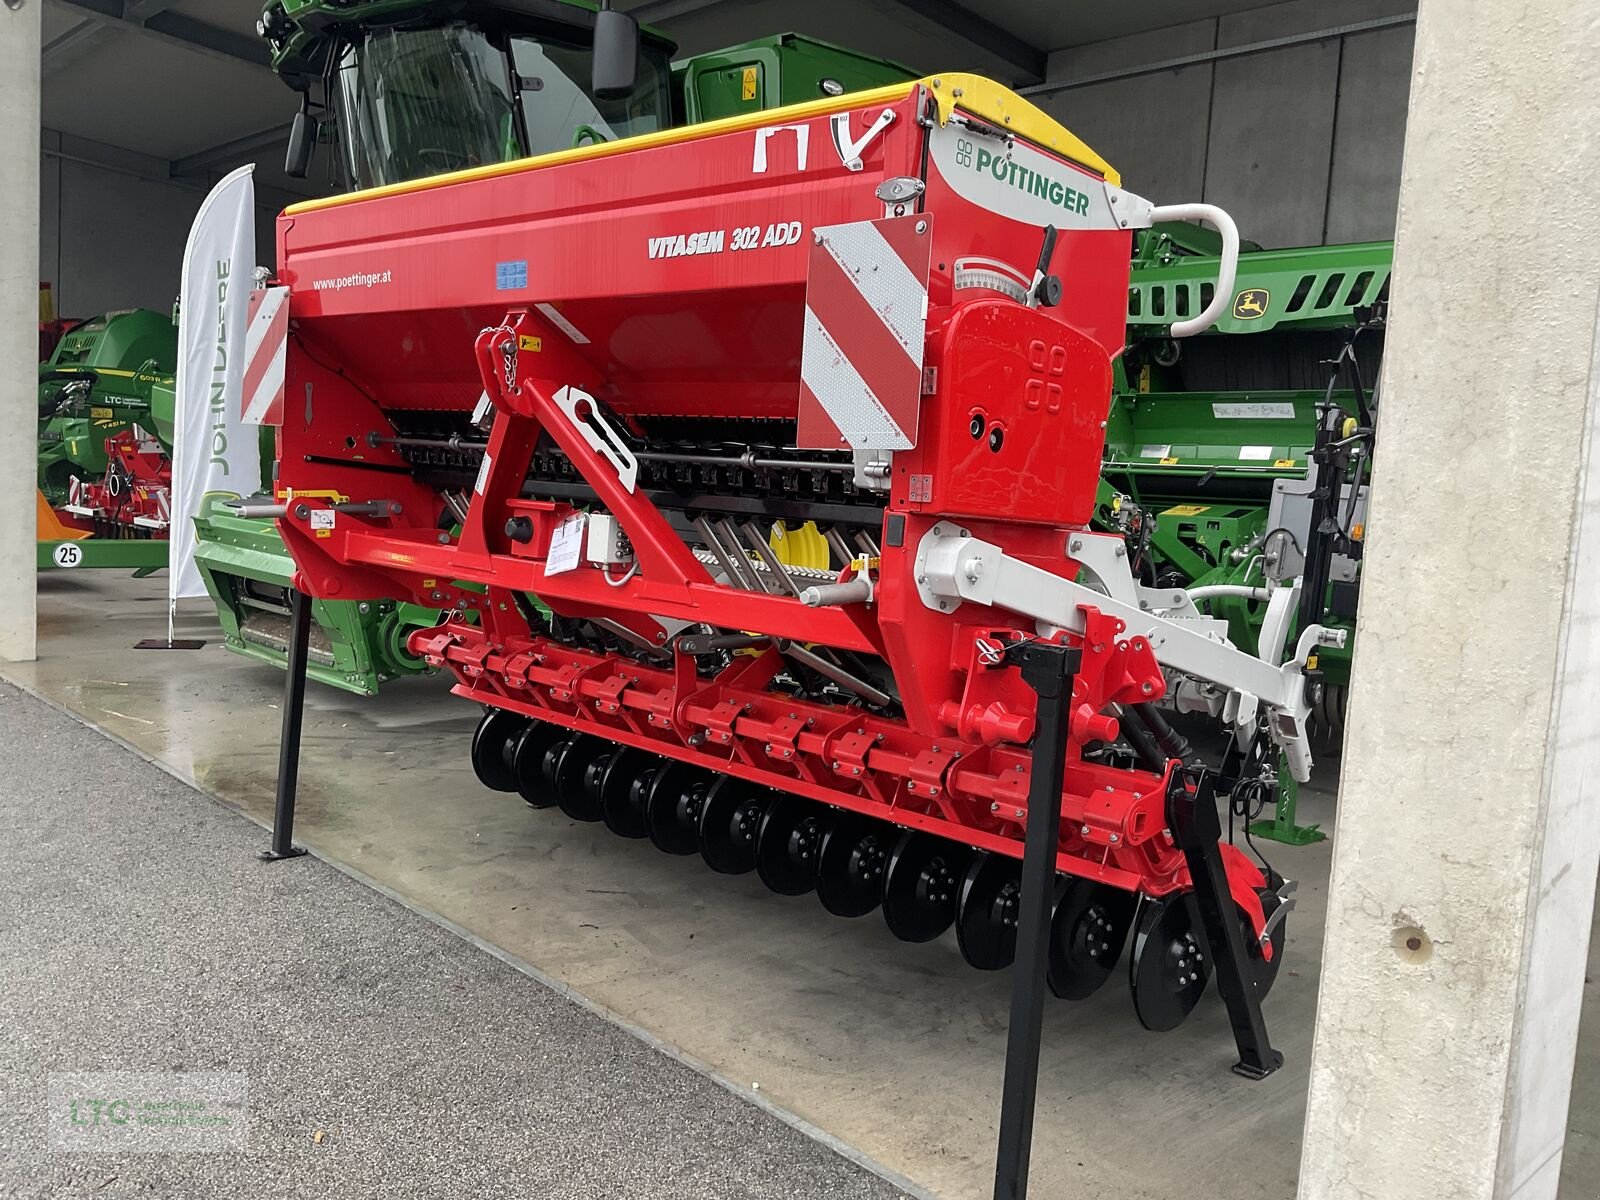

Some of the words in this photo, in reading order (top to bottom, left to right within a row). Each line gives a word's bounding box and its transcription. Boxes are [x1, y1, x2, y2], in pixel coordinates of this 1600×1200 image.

[976, 147, 1090, 217] PÖTTINGER
[648, 230, 725, 259] VITASEM
[730, 226, 761, 251] 302
[761, 221, 802, 248] ADD
[313, 269, 392, 291] www.poettinger.at
[105, 396, 121, 404] LTC
[209, 382, 229, 476] JOHN
[60, 547, 77, 563] 25
